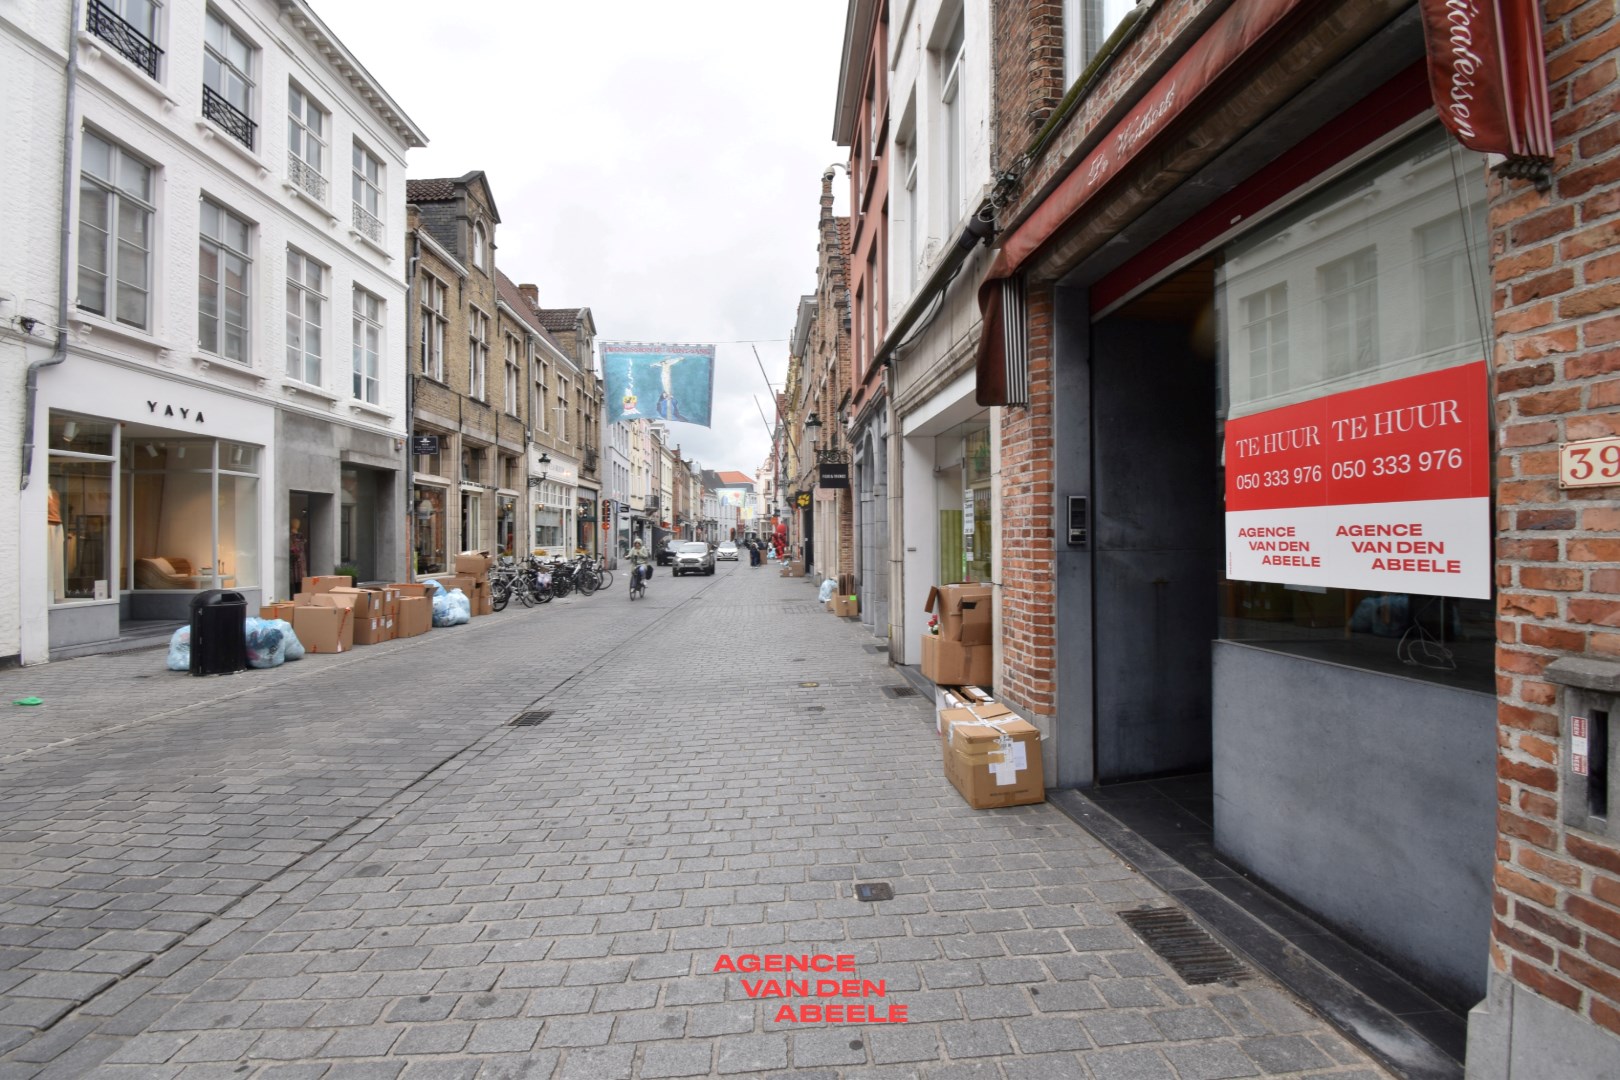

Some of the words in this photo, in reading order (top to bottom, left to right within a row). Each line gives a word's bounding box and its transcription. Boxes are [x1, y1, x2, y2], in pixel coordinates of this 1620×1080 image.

[1445, 0, 1483, 139] icatessen
[147, 400, 205, 423] YAYA
[1331, 415, 1368, 442] TE
[1373, 399, 1462, 436] HUUR
[1235, 436, 1260, 458] TE
[1263, 425, 1321, 454] HUUR
[1331, 459, 1366, 480] 050
[1372, 454, 1411, 476] 333
[1418, 448, 1463, 472] 976
[1569, 445, 1620, 480] 39
[1236, 473, 1260, 490] 050
[1263, 470, 1290, 487] 333
[1293, 465, 1322, 484] 976
[1238, 526, 1296, 538] AGENCE
[1335, 523, 1423, 537] AGENCE
[1248, 541, 1276, 552] VAN
[1278, 541, 1310, 552] DEN
[1351, 541, 1392, 554] VAN
[1396, 541, 1445, 555] DEN
[1262, 555, 1321, 568] ABEELE
[1371, 558, 1461, 574] ABEELE
